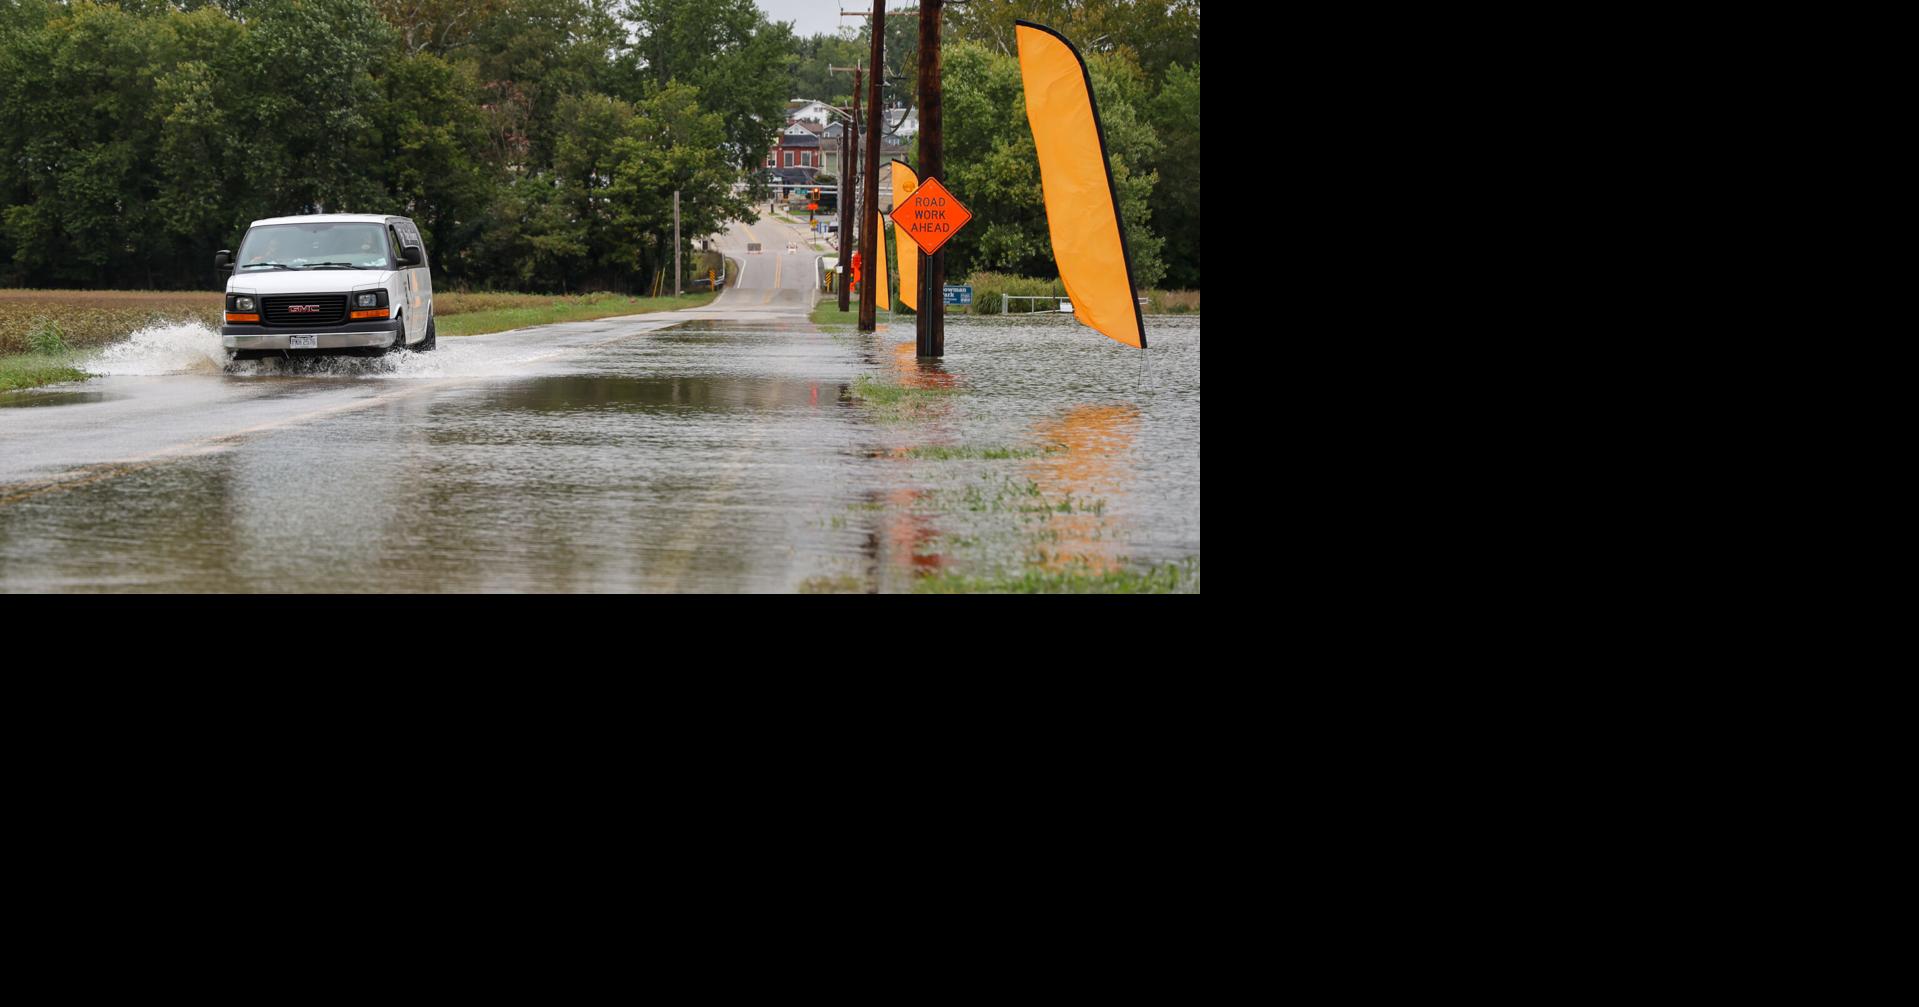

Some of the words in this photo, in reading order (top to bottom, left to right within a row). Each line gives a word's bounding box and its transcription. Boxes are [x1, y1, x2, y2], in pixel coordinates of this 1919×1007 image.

[915, 197, 946, 207] ROAD
[915, 210, 946, 220] WORK
[911, 223, 950, 233] AHEAD
